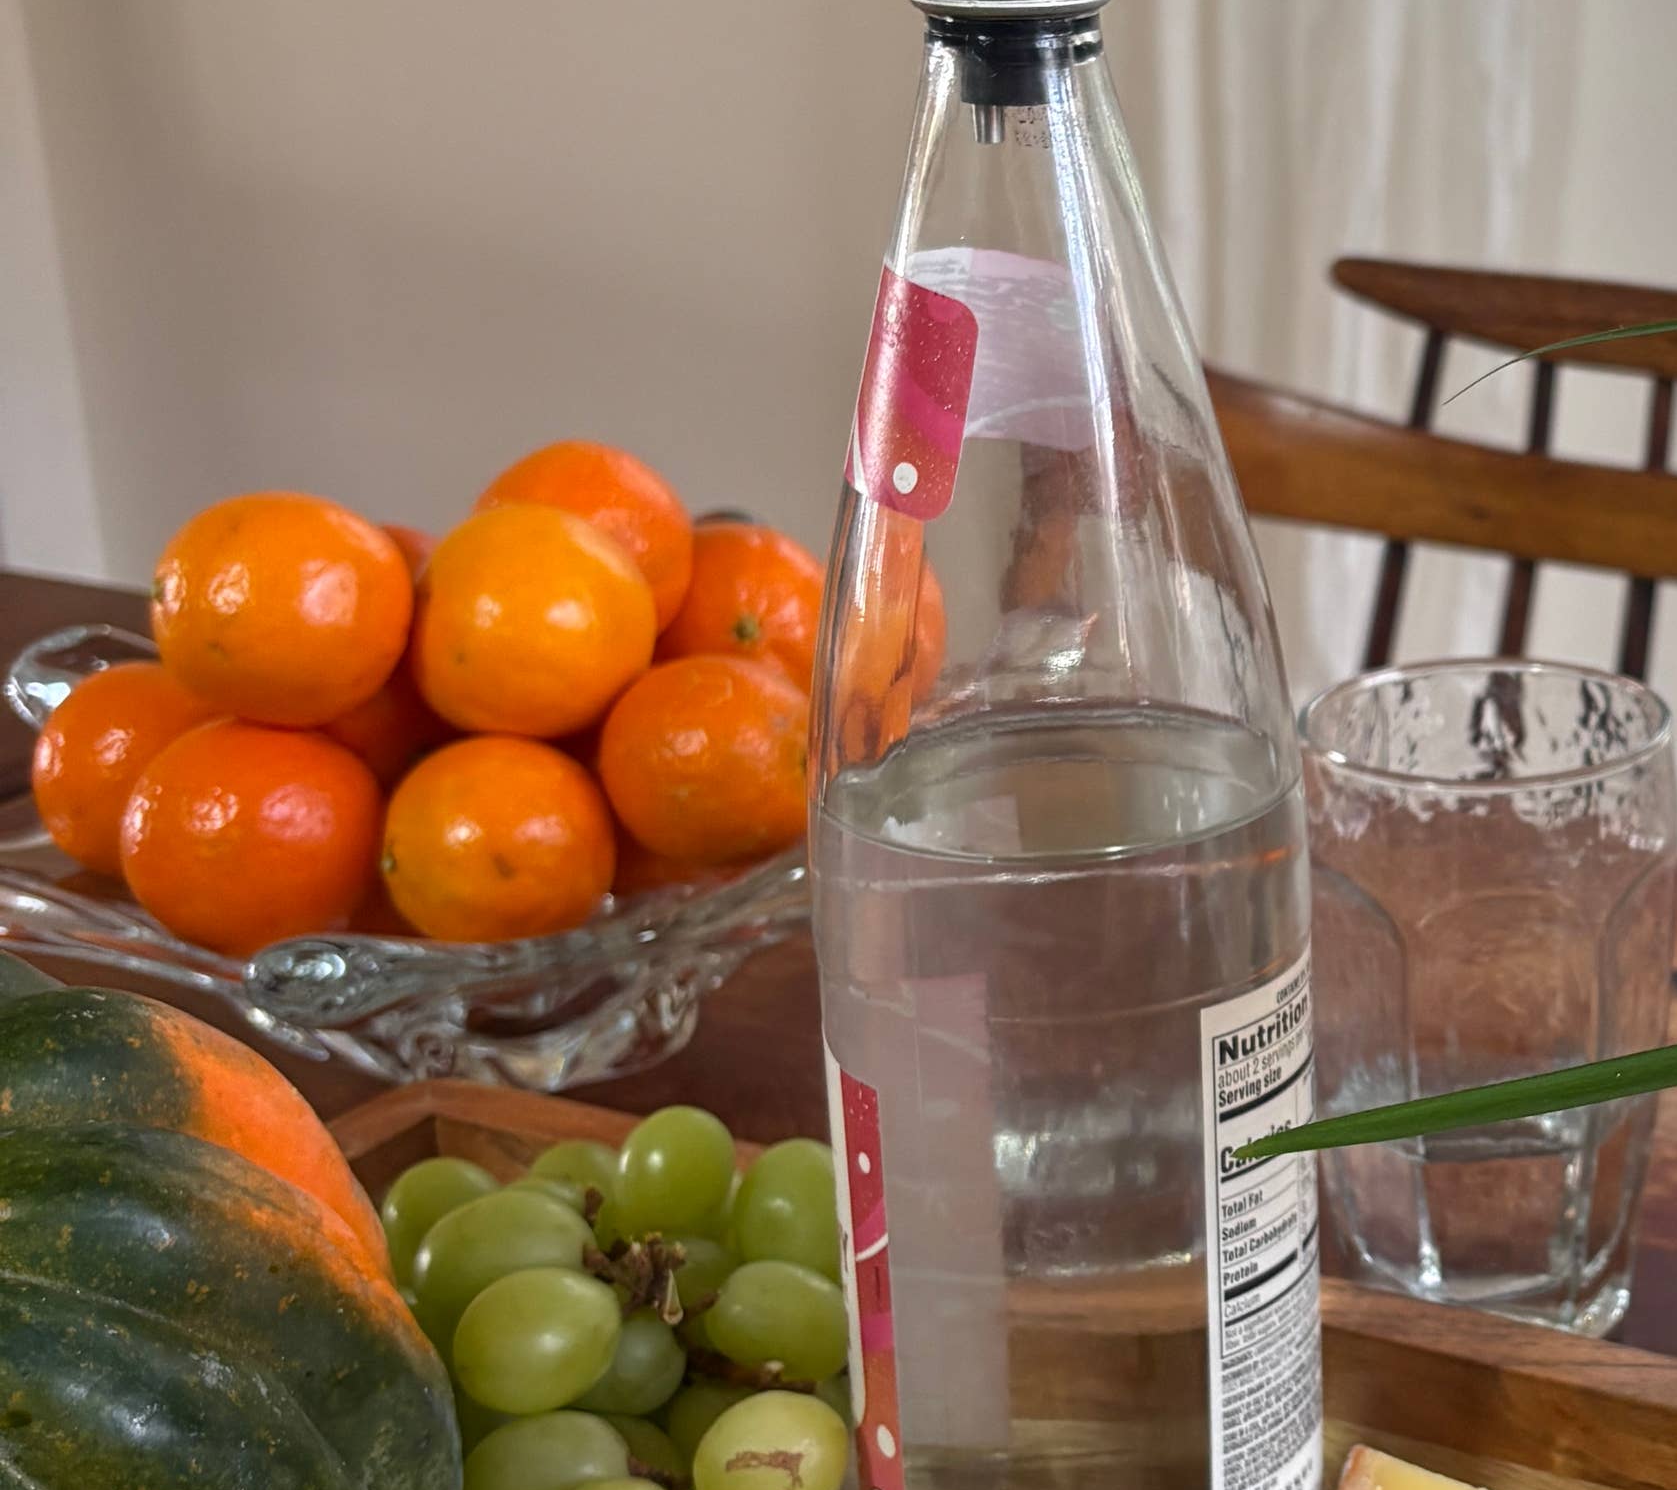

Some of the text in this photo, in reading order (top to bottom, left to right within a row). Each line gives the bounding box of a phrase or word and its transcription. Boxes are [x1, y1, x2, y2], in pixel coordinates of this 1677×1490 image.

[1219, 994, 1308, 1065] Nutrition
[1218, 1067, 1249, 1089] about
[1253, 1058, 1260, 1074] 2
[1218, 1066, 1282, 1109] Serving size
[1221, 1189, 1264, 1218] Total Fat
[1221, 1217, 1257, 1242] Sodium
[1222, 1244, 1247, 1264] Total
[1223, 1261, 1259, 1286] Protein
